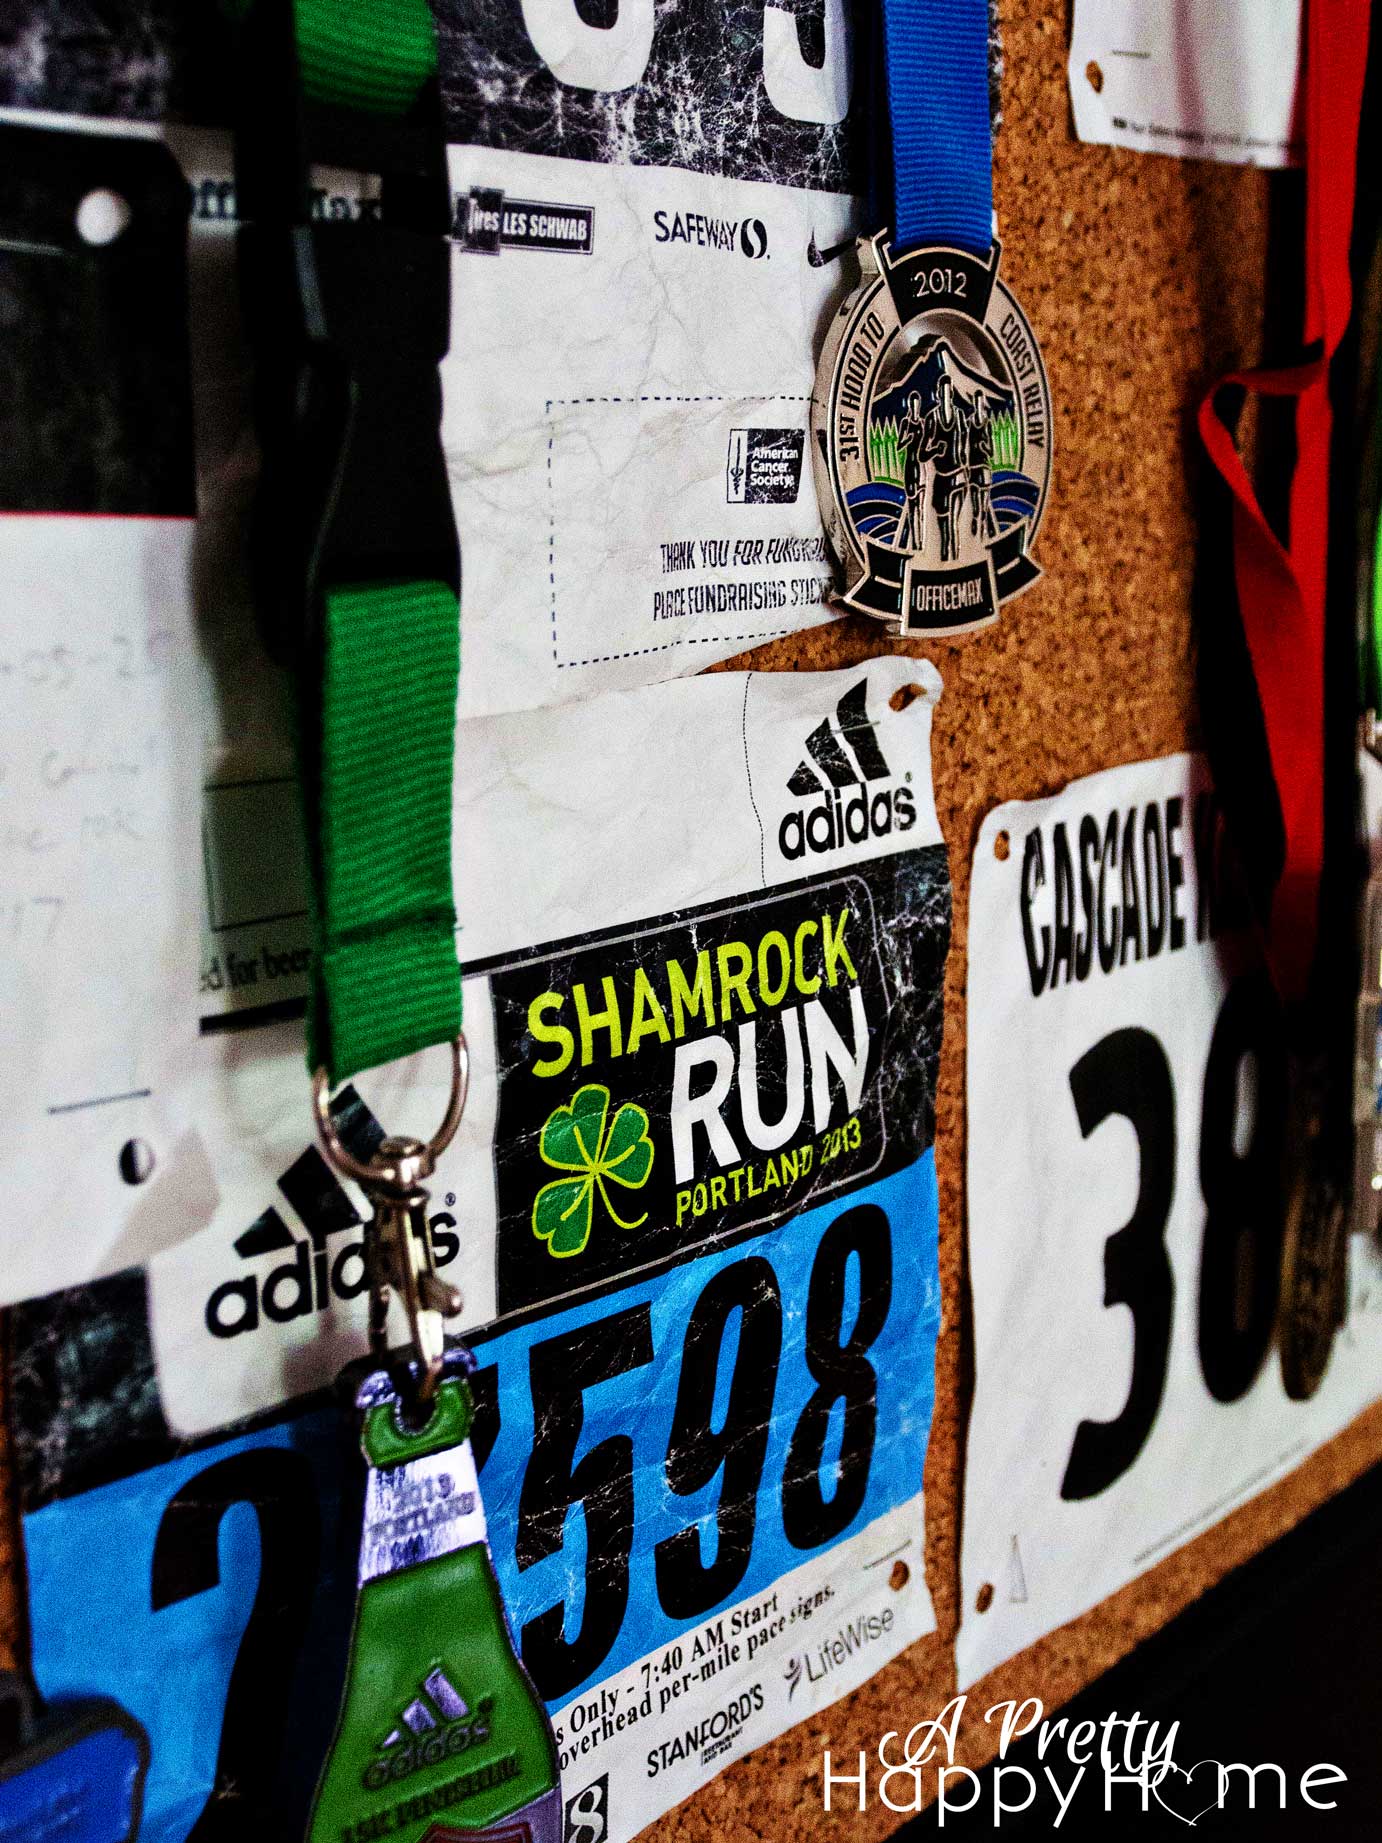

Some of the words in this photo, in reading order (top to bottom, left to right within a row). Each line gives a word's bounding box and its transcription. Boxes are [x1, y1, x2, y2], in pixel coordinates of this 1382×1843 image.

[502, 211, 528, 236] LES
[529, 213, 588, 242] SCHWAB
[653, 210, 738, 252] SAFEWAY
[913, 268, 967, 298] 2012
[860, 311, 885, 349] TO
[840, 342, 875, 412] HOOD
[1000, 312, 1037, 383] COAST
[1022, 381, 1046, 449] RELAY
[750, 459, 790, 474] Cancer
[752, 446, 799, 460] American
[839, 413, 861, 463] 31ST
[750, 473, 791, 489] Society
[660, 540, 696, 574] THANK
[699, 539, 731, 568] YOU
[733, 539, 765, 567] FOR
[653, 586, 687, 621] PLACE
[687, 580, 787, 615] FUNDRAISING
[916, 577, 984, 612] OFFICEMAX
[779, 781, 917, 861] adidas
[1020, 796, 1186, 998] CASCADE
[527, 907, 858, 1078] SHAMROCK
[671, 986, 869, 1184] RUN
[675, 1145, 814, 1228] PORTLAND
[820, 1116, 862, 1166] 2013
[204, 1211, 461, 1340] adids
[559, 1690, 652, 1771] overhead
[659, 1643, 741, 1714] per-mile
[746, 1616, 786, 1661] pace
[789, 1584, 836, 1625] signs.
[570, 1687, 620, 1733] Only
[641, 1646, 683, 1690] 7:40
[691, 1620, 725, 1662] AM
[731, 1592, 778, 1636] Start
[804, 1607, 894, 1683] LifeWise
[647, 1683, 764, 1778] STANFORD'S
